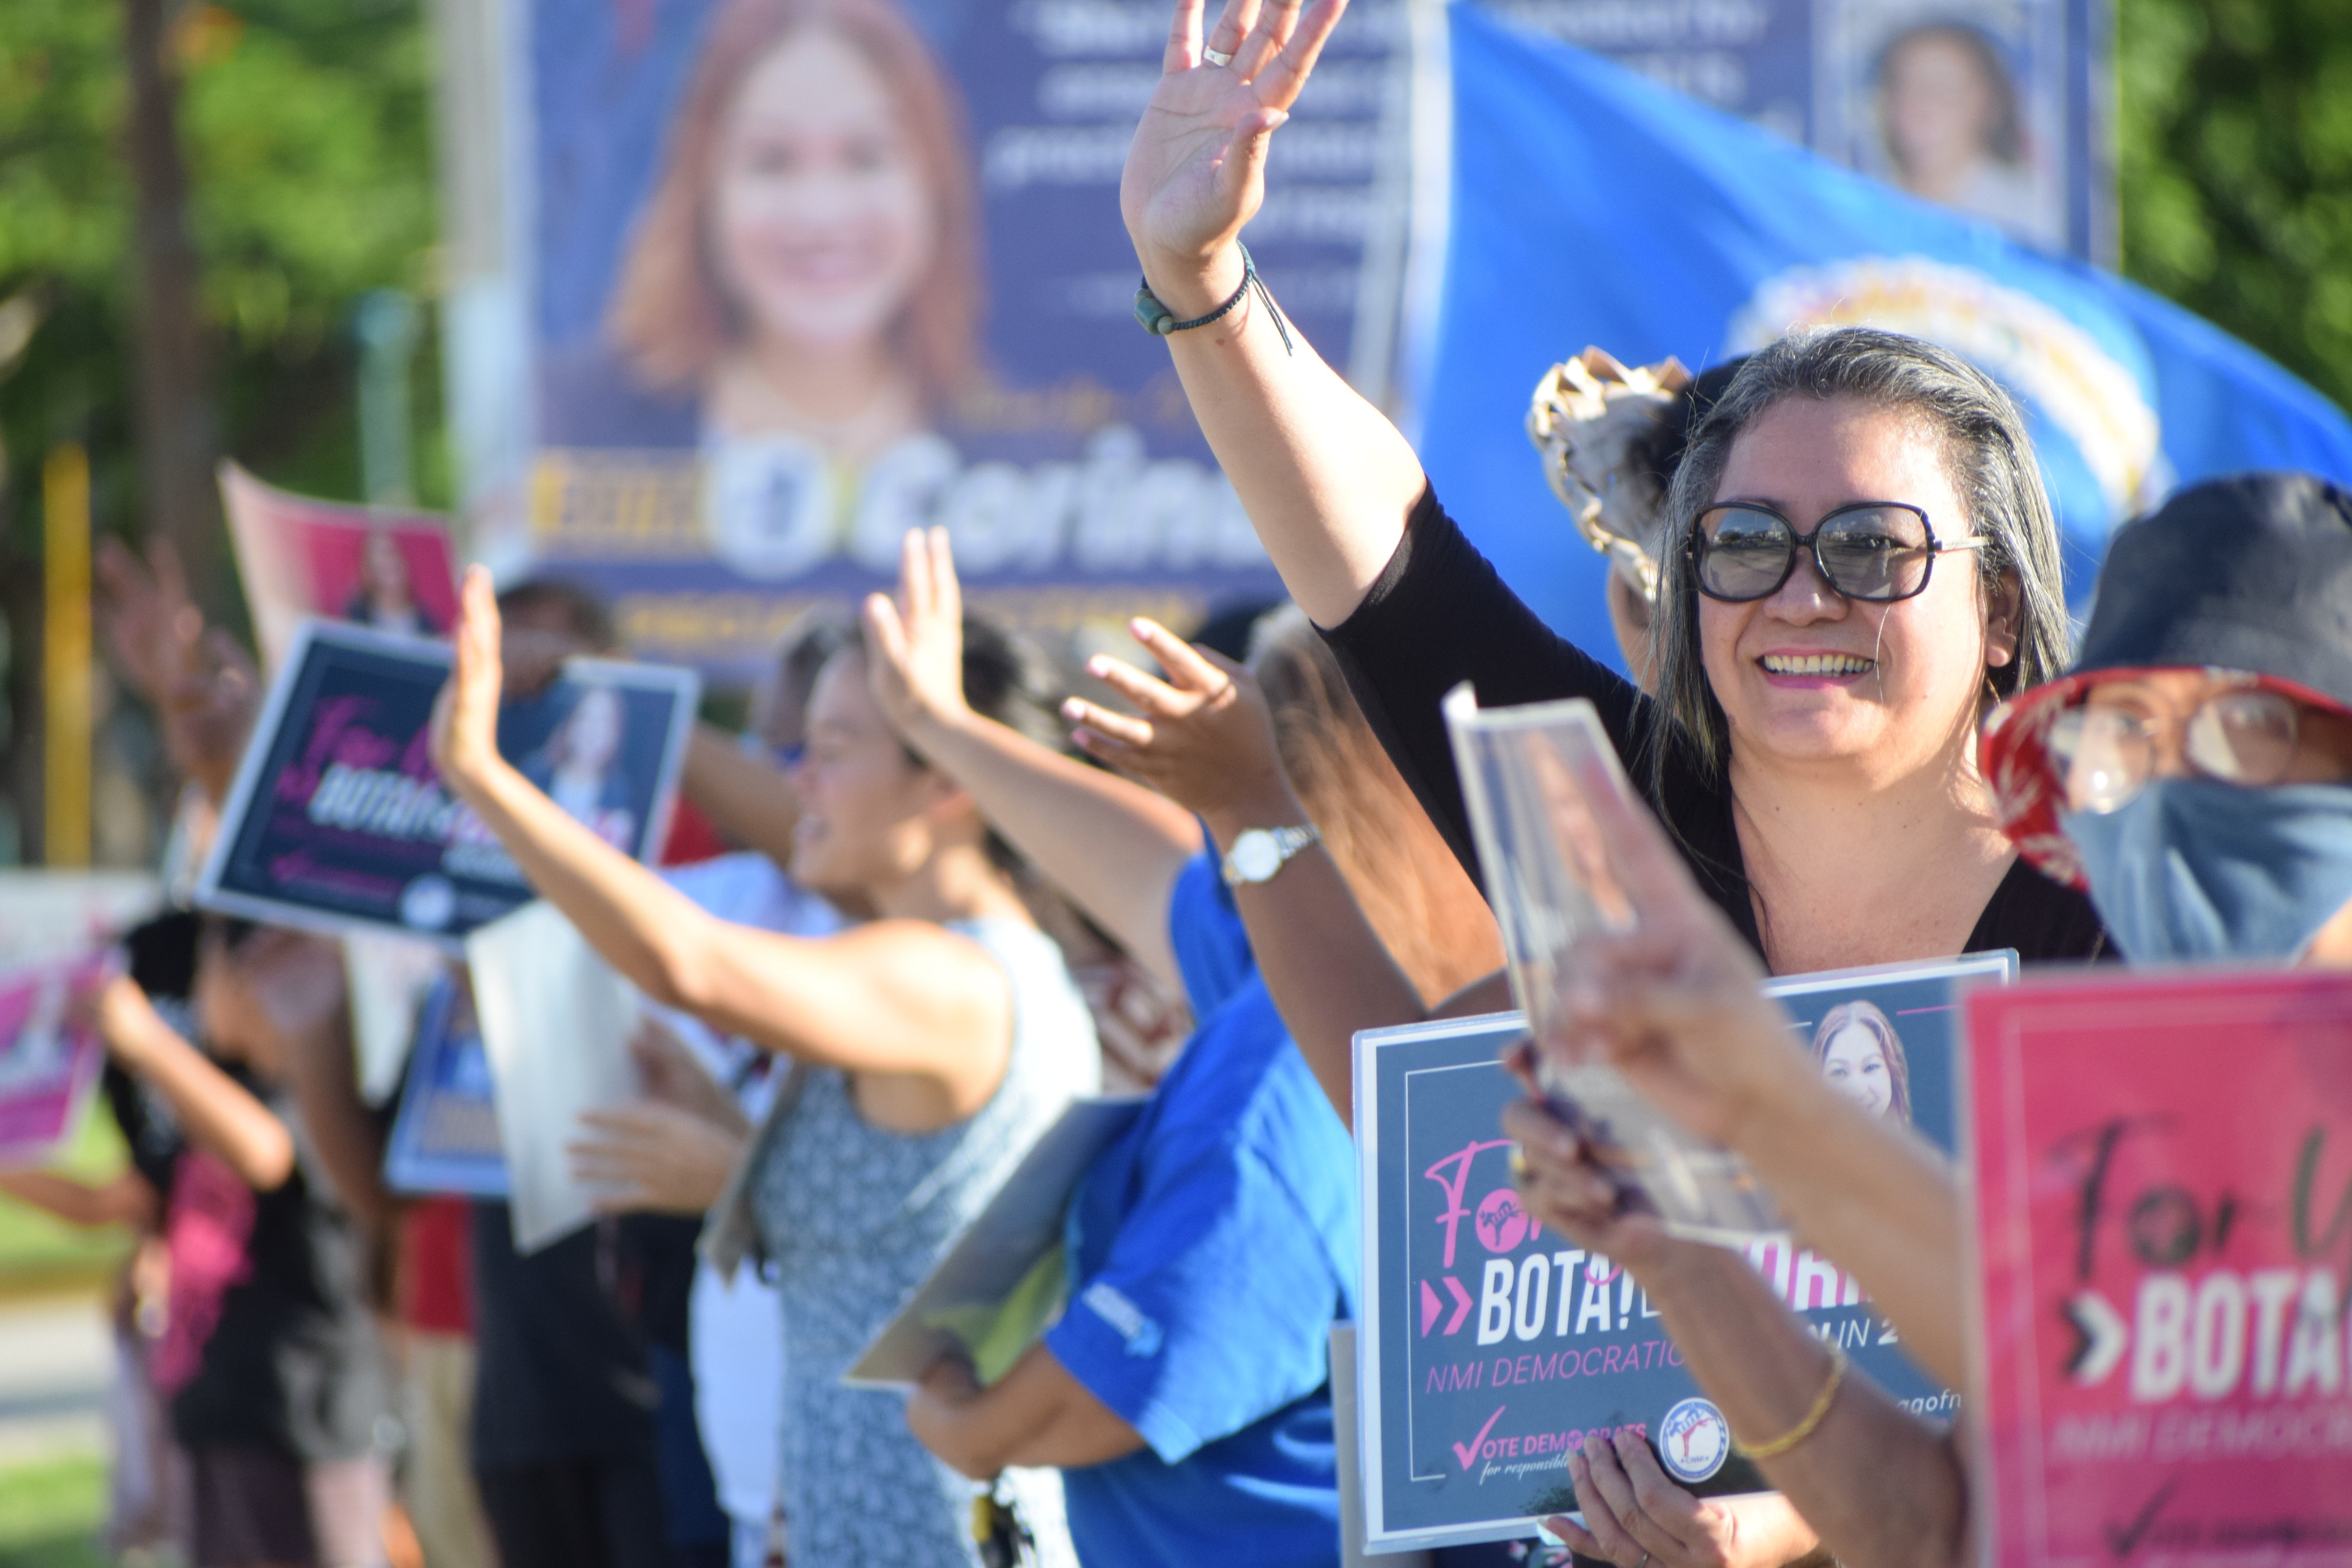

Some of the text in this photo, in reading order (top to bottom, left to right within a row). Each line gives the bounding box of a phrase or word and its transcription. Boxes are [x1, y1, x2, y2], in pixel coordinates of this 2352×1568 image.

[854, 428, 1268, 563] Corin
[1477, 1249, 1635, 1346] BOTA!
[1836, 1318, 1871, 1349] IN
[2132, 1267, 2352, 1401] BOTA
[1426, 1361, 1483, 1395] NMI
[1480, 1460, 1501, 1486] for
